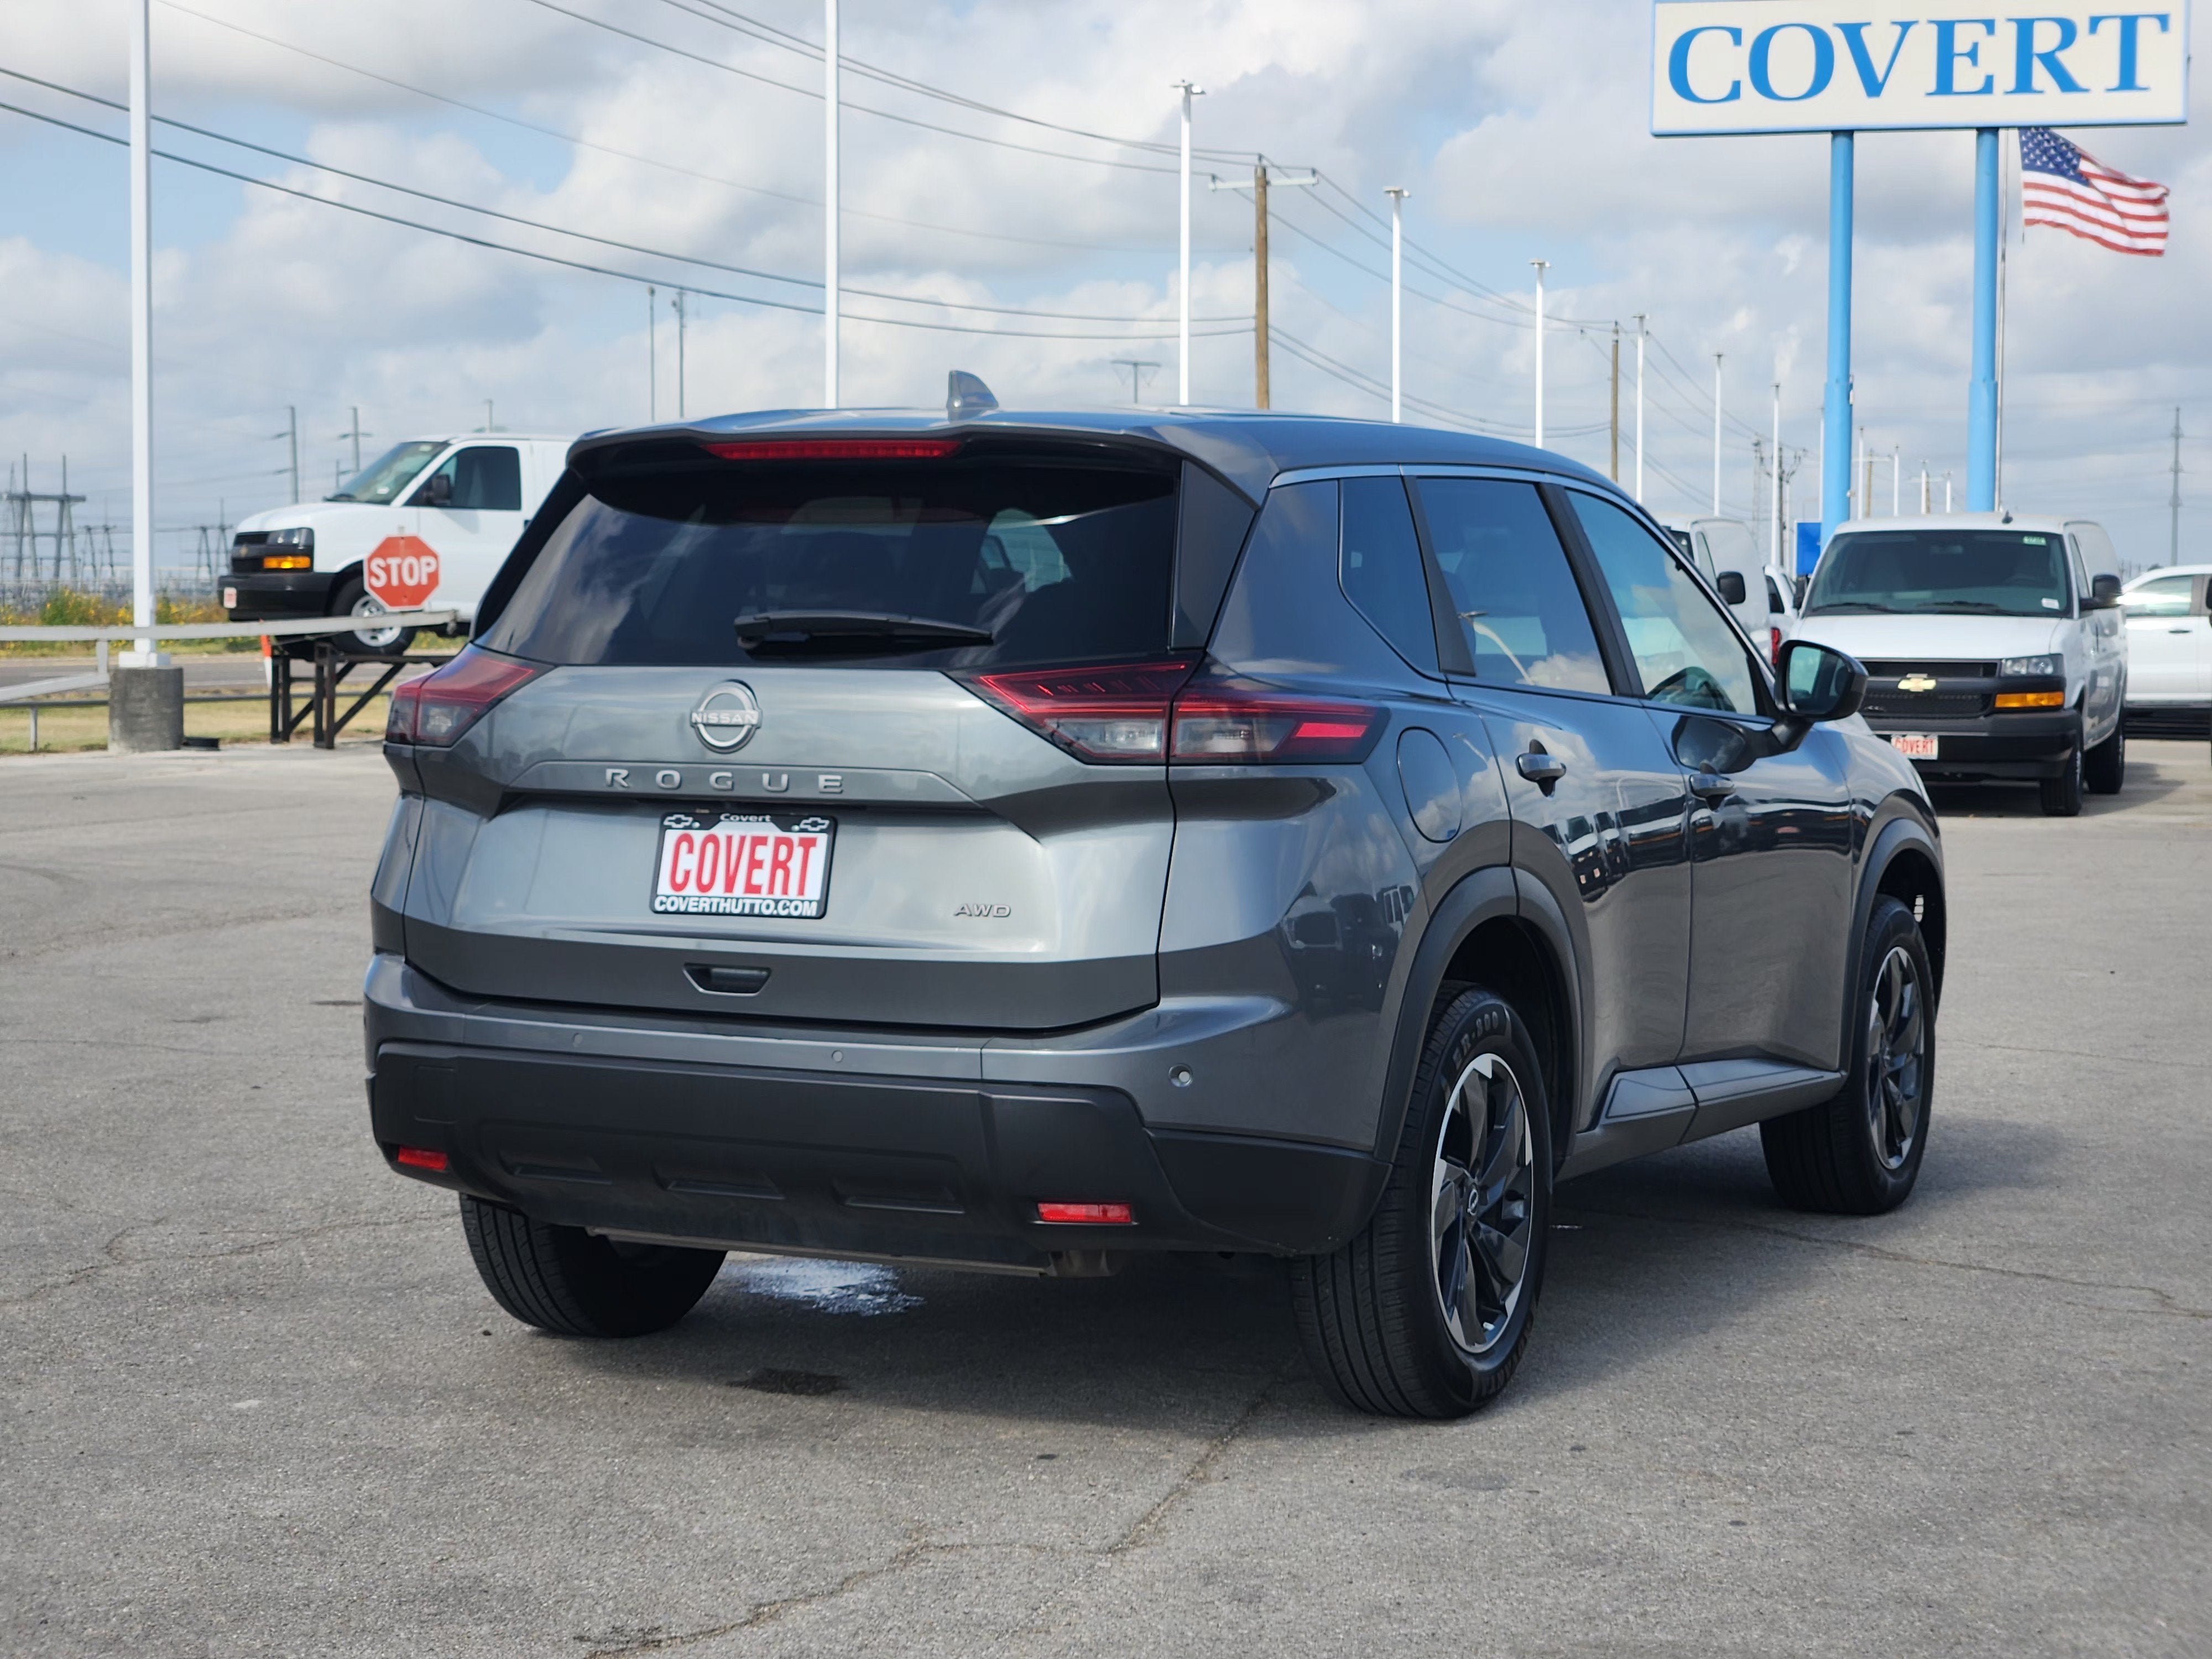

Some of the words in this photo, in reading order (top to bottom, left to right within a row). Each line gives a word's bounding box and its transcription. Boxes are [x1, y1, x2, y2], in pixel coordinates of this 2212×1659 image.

[1668, 13, 2170, 104] COVERT
[369, 555, 437, 588] STOP
[691, 711, 758, 725] NISSAN
[1895, 738, 1933, 753] COVERT
[605, 768, 844, 793] ROGUE
[720, 813, 771, 822] Covert
[669, 832, 817, 897] COVERT
[654, 895, 818, 917] COVERTHUTTO.COM
[954, 903, 1011, 918] AWD
